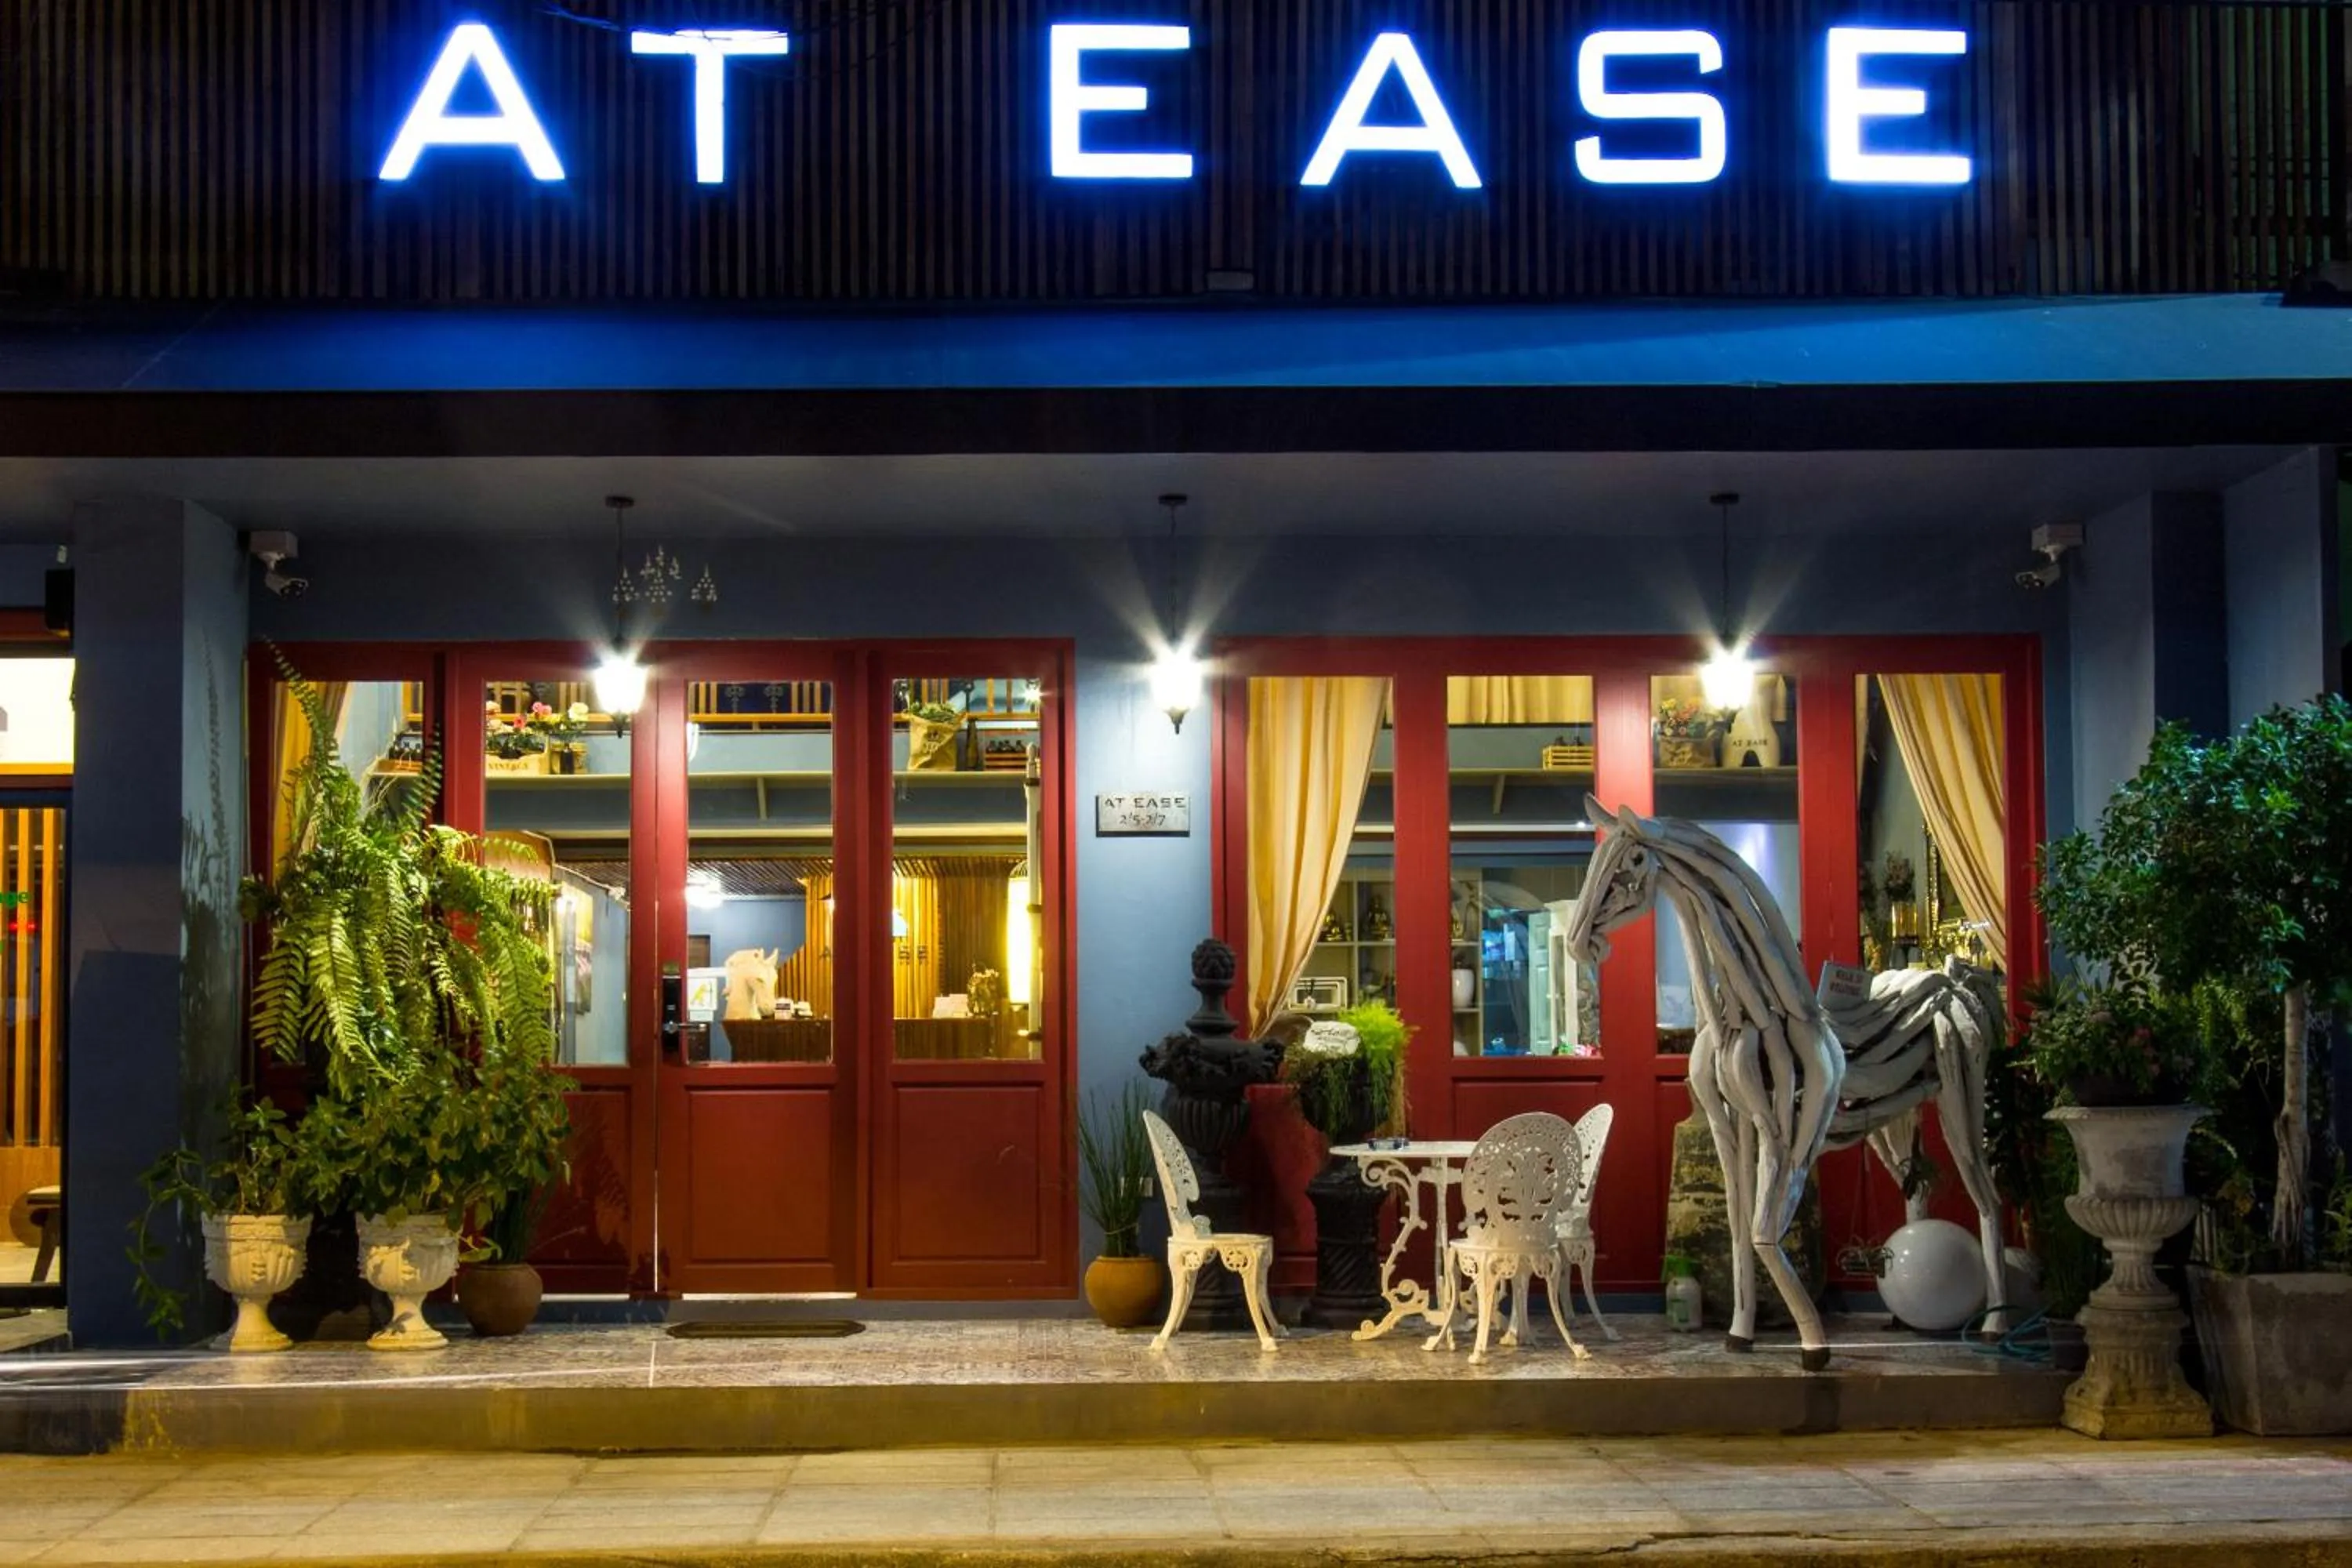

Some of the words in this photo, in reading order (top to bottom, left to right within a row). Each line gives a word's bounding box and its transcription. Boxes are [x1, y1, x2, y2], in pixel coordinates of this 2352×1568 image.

[379, 24, 788, 183] AT
[1049, 24, 1971, 188] EASE
[1104, 797, 1125, 808] AT
[1134, 797, 1186, 808] EASE
